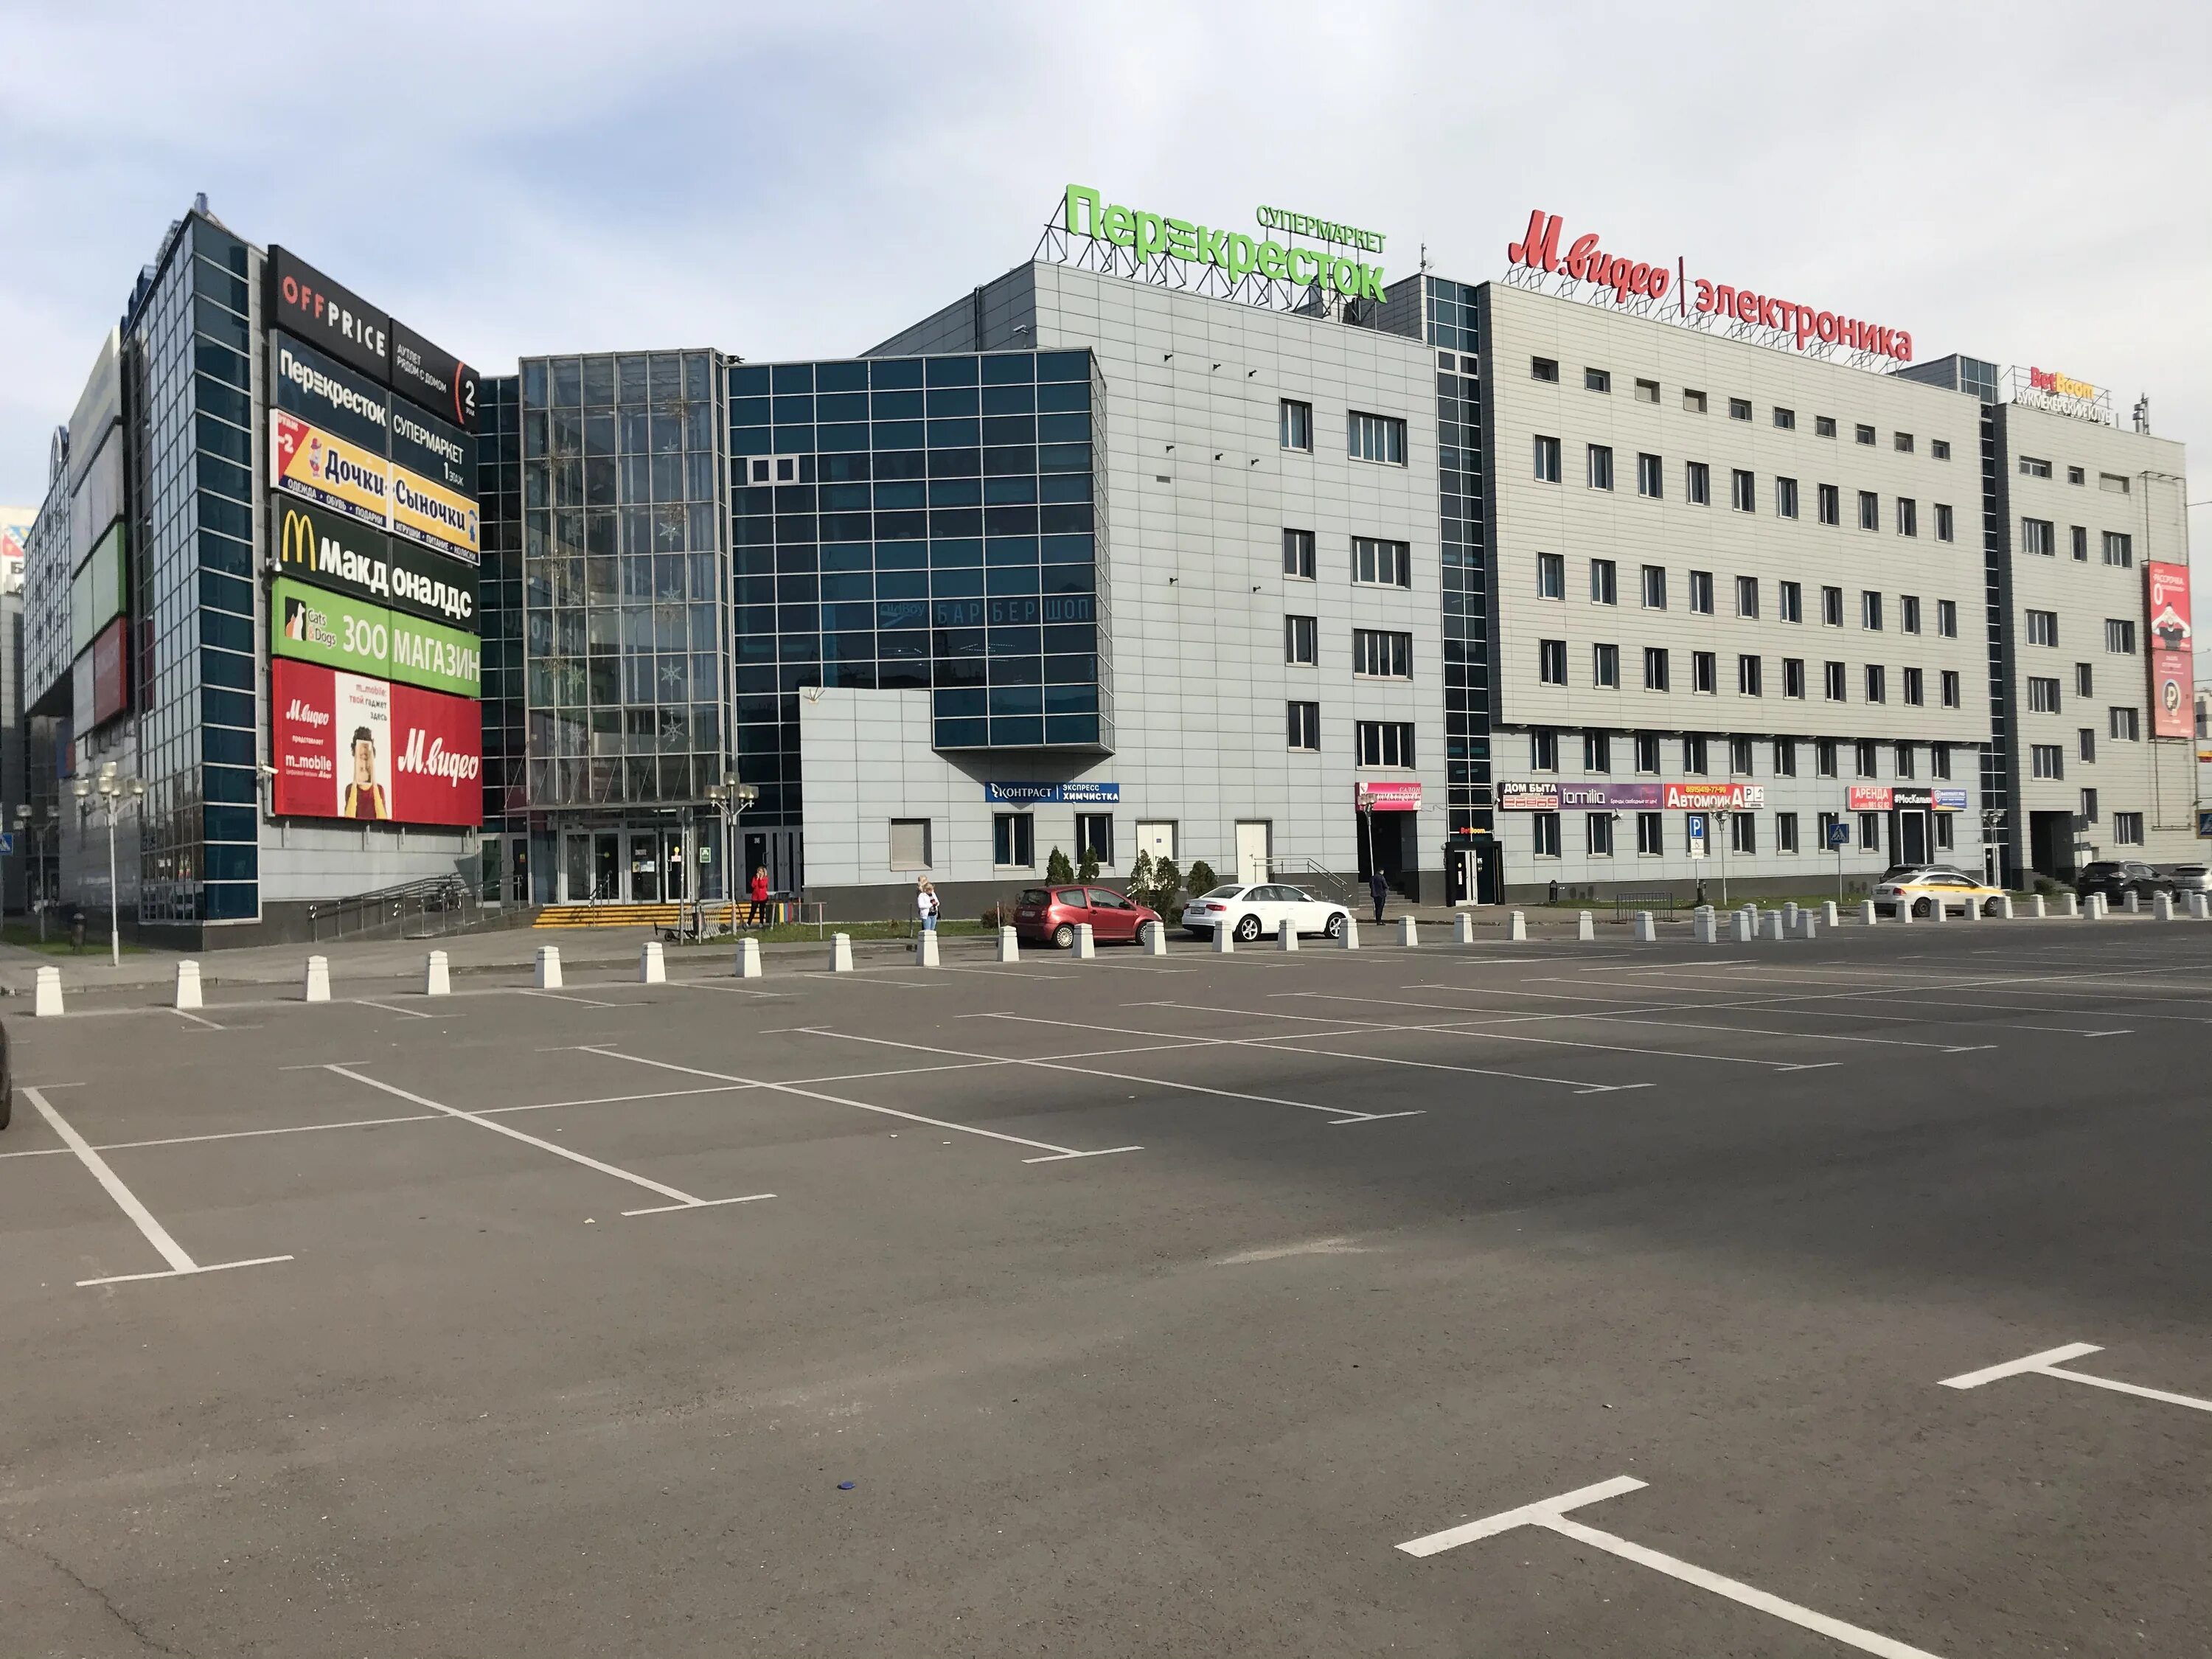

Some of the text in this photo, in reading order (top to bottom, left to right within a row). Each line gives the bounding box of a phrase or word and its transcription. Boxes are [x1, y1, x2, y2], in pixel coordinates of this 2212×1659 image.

[1256, 205, 1387, 253] СУПЕРМАРКЕТ
[1066, 184, 1388, 303] Перекресток
[1508, 209, 1913, 362] М.видео электроника
[397, 344, 422, 366] АУТЛЕТ
[397, 355, 447, 394] РЯДОМ С ДОМОМ
[2031, 366, 2093, 400] BetBoom
[280, 349, 386, 427] Перекресток
[465, 380, 475, 407] 2
[393, 414, 464, 465] СУПЕРМАРКЕТ
[444, 462, 465, 487] 1 ЭТАЖ
[288, 479, 317, 499] ОДЕЖДА
[326, 495, 347, 511] ОБУВЬ
[308, 610, 326, 626] Cats
[316, 628, 335, 647] Dogs
[349, 695, 387, 709] твой гаджет
[370, 712, 387, 721] здесь
[285, 754, 332, 771] m_mobile
[397, 728, 479, 788] М.видео
[999, 787, 1051, 799] КОНТРАСТ
[1062, 793, 1119, 801] ХИМЧИСТКА
[1504, 783, 1557, 793] ДОМ БЫТА
[1562, 788, 1605, 804] familia
[1855, 788, 1888, 801] АРЕНДА
